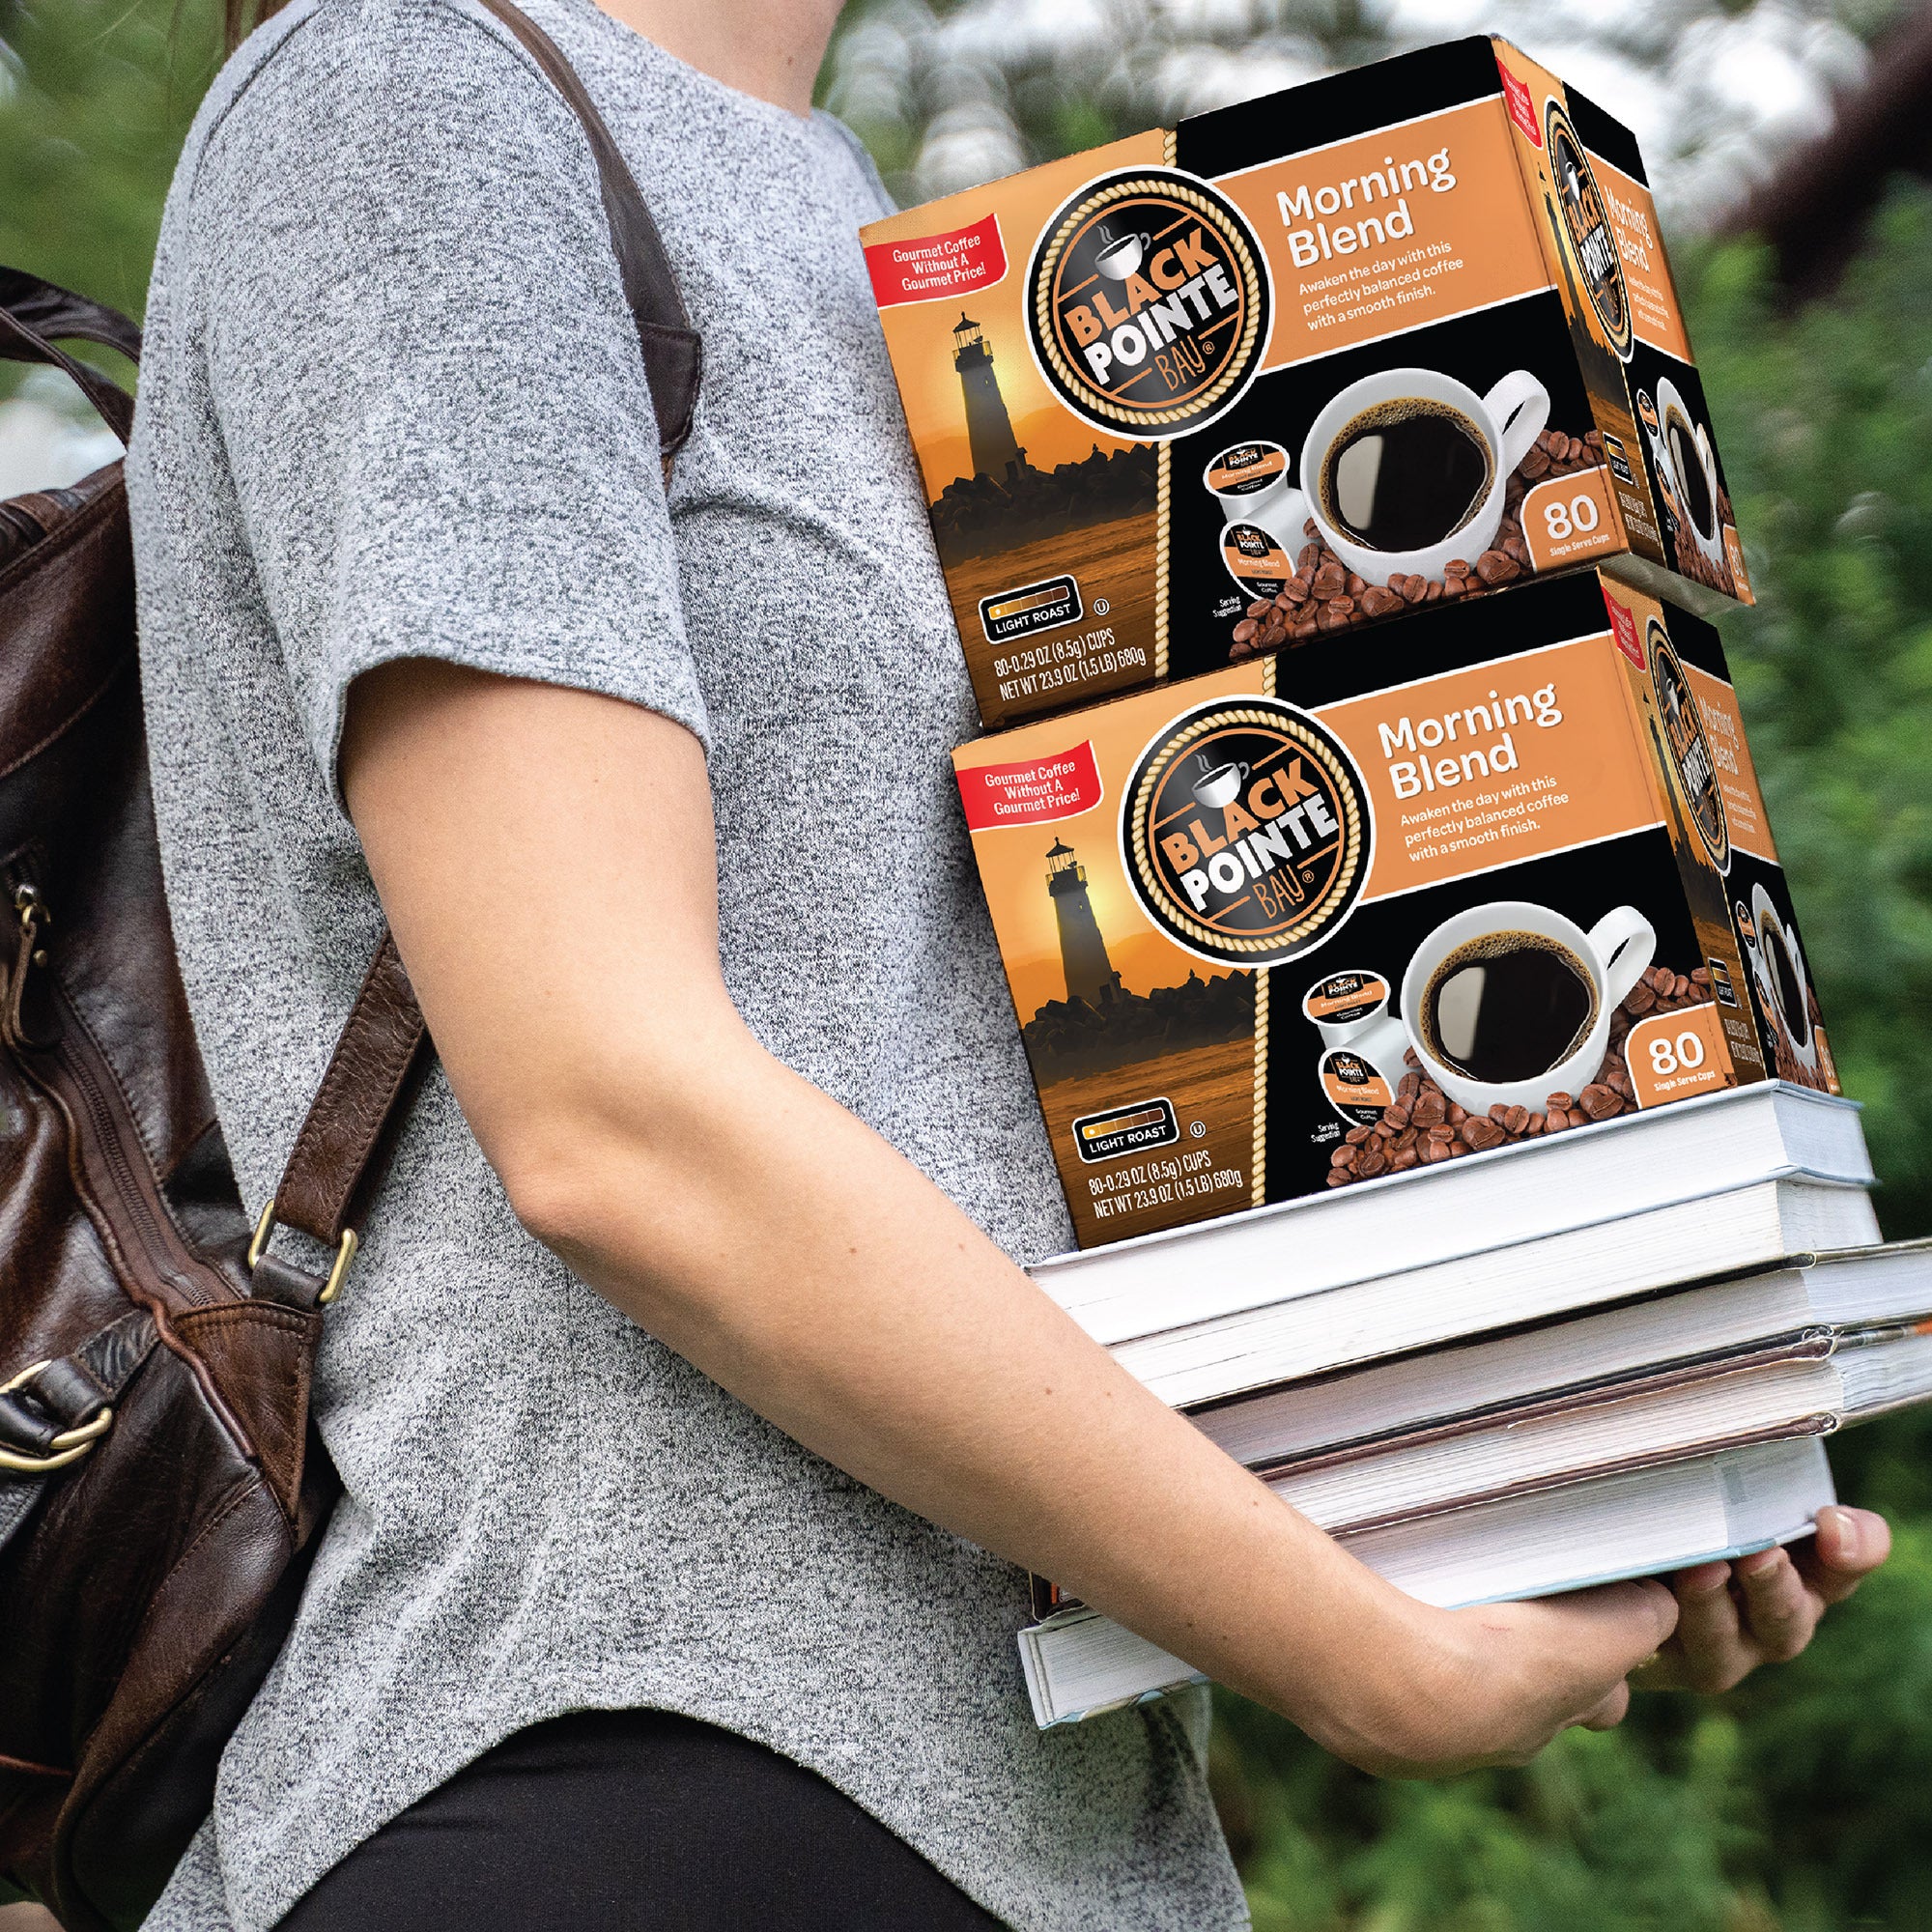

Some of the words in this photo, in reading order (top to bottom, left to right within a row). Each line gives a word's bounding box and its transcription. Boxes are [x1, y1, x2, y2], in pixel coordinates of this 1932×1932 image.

[1276, 148, 1457, 226] Morning
[893, 243, 943, 263] Gourmet
[944, 234, 980, 253] Coffee
[1288, 199, 1414, 268] Blend
[901, 271, 952, 291] Gourmet
[953, 262, 986, 281] Price!
[913, 256, 958, 274] Without
[959, 254, 969, 267] A
[1299, 272, 1348, 295] Awaken
[1350, 266, 1370, 281] the
[1372, 258, 1396, 273] day
[1398, 249, 1426, 266] with
[1426, 242, 1452, 257] this
[1303, 288, 1360, 315] perfectly
[1362, 271, 1420, 296] balanced
[1423, 258, 1463, 277] coffee
[1065, 228, 1218, 347] BLACK
[1308, 315, 1335, 330] with
[1338, 312, 1346, 322] a
[1347, 298, 1395, 320] smooth
[1397, 285, 1435, 306] finish.
[1083, 264, 1238, 384] POINTE
[1545, 495, 1599, 539] 80
[1549, 545, 1571, 556] Single
[1572, 539, 1592, 551] Serve
[1593, 534, 1610, 545] Cups
[996, 616, 1029, 634] LIGHT
[1033, 604, 1070, 622] ROAST
[1212, 605, 1242, 617] Suggestion
[1220, 597, 1240, 607] Serving
[994, 651, 1036, 677] 80-0.29
[1037, 645, 1052, 665] OZ
[1052, 636, 1086, 662] (8.5g)
[1087, 628, 1115, 651] CUPS
[1000, 680, 1020, 701] NET
[1020, 674, 1038, 696] WT
[1039, 668, 1063, 691] 23.9
[1064, 664, 1078, 683] OZ
[1079, 659, 1096, 681] (1.5
[1098, 652, 1118, 673] LB)
[1118, 646, 1147, 668] 680g
[1378, 683, 1563, 758] Morning
[984, 769, 1037, 787] Gourmet
[1037, 759, 1076, 780] Coffee
[1388, 733, 1519, 799] Blend
[994, 798, 1046, 815] Gourmet
[1047, 788, 1080, 810] Price!
[1005, 781, 1051, 800] Without
[1054, 780, 1064, 792] A
[1401, 806, 1449, 826] Awaken
[1452, 799, 1473, 813] the
[1475, 792, 1499, 809] day
[1501, 784, 1530, 800] with
[1530, 776, 1556, 791] this
[1160, 757, 1319, 874] BLACK
[1405, 821, 1463, 846] perfectly
[1465, 806, 1525, 828] balanced
[1527, 793, 1569, 811] coffee
[1179, 793, 1339, 912] POINTE
[1409, 846, 1437, 862] with
[1440, 843, 1448, 854] a
[1449, 830, 1498, 852] smooth
[1500, 819, 1540, 839] finish.
[1649, 1032, 1704, 1074] 80
[1654, 1080, 1676, 1092] Single
[1677, 1074, 1697, 1086] Serve
[1698, 1070, 1716, 1082] Cups
[1090, 1137, 1124, 1153] LIGHT
[1127, 1125, 1166, 1143] ROAST
[1318, 1122, 1339, 1132] Serving
[1089, 1171, 1130, 1196] 80-0.29
[1131, 1166, 1148, 1185] OZ
[1147, 1157, 1182, 1183] (8.5g)
[1182, 1150, 1211, 1172] CUPS
[1094, 1198, 1114, 1219] NET
[1114, 1193, 1133, 1214] WT
[1134, 1188, 1158, 1209] 23.9
[1159, 1184, 1174, 1203] OZ
[1175, 1179, 1193, 1202] (1.5
[1195, 1173, 1213, 1194] LB)
[1213, 1169, 1243, 1188] 680g
